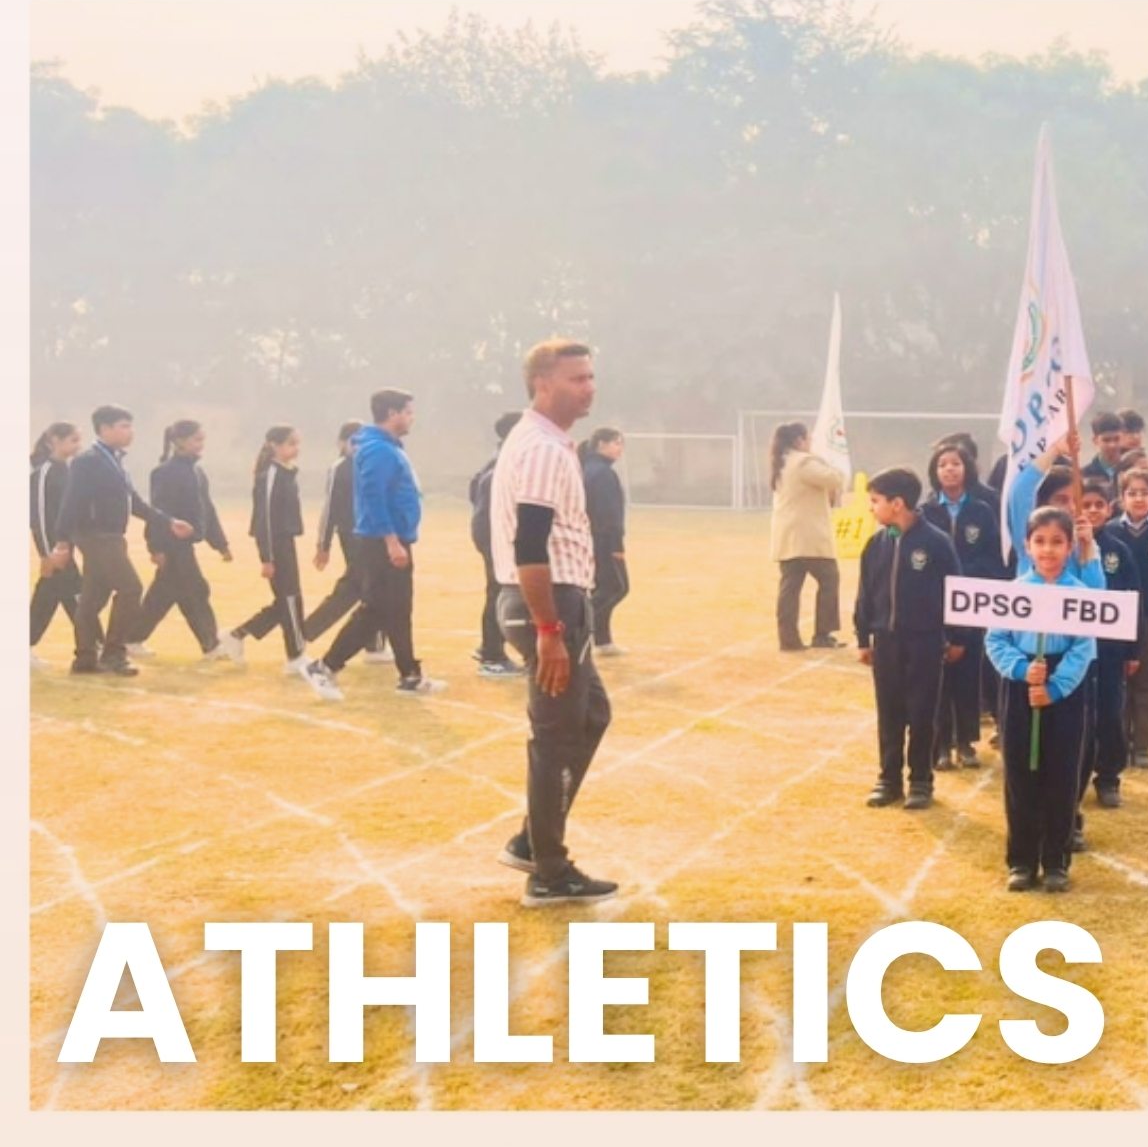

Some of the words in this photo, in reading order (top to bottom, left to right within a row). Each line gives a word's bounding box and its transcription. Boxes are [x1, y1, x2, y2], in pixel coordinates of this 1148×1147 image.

[836, 517, 864, 540] #1
[951, 590, 1033, 619] DPSG
[1062, 598, 1120, 625] FBD
